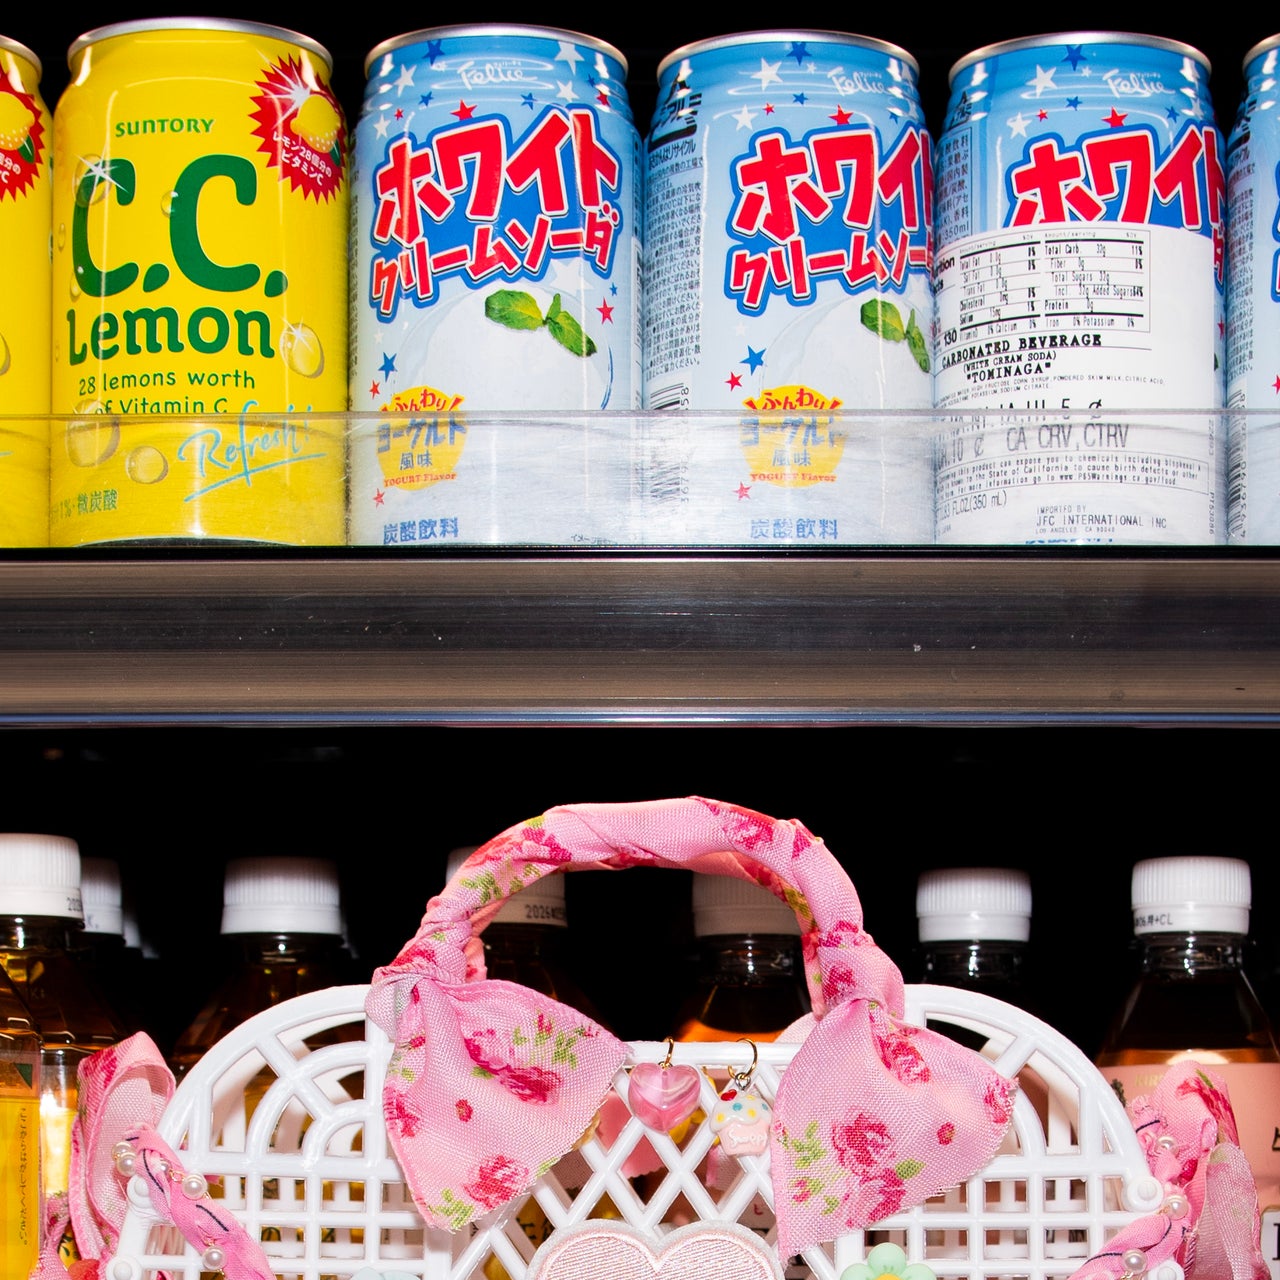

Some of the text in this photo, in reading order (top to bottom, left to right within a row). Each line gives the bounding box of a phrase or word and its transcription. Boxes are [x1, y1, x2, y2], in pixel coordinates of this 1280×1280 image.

[115, 117, 215, 138] SUNTORY
[375, 108, 617, 244] ホワイト
[374, 206, 620, 313] クリームソーダ
[67, 305, 275, 366] Lemon
[942, 334, 1102, 370] CARBONATED BEVERAGE
[1028, 351, 1056, 362] SODA)
[78, 369, 255, 396] 28 lemons worth
[383, 472, 457, 488] YOGURT Flavor
[383, 517, 458, 546] 炭酸飲料
[750, 519, 838, 540] 炭酸飲料
[1037, 515, 1166, 528] JFC INTERNATIONAL INC
